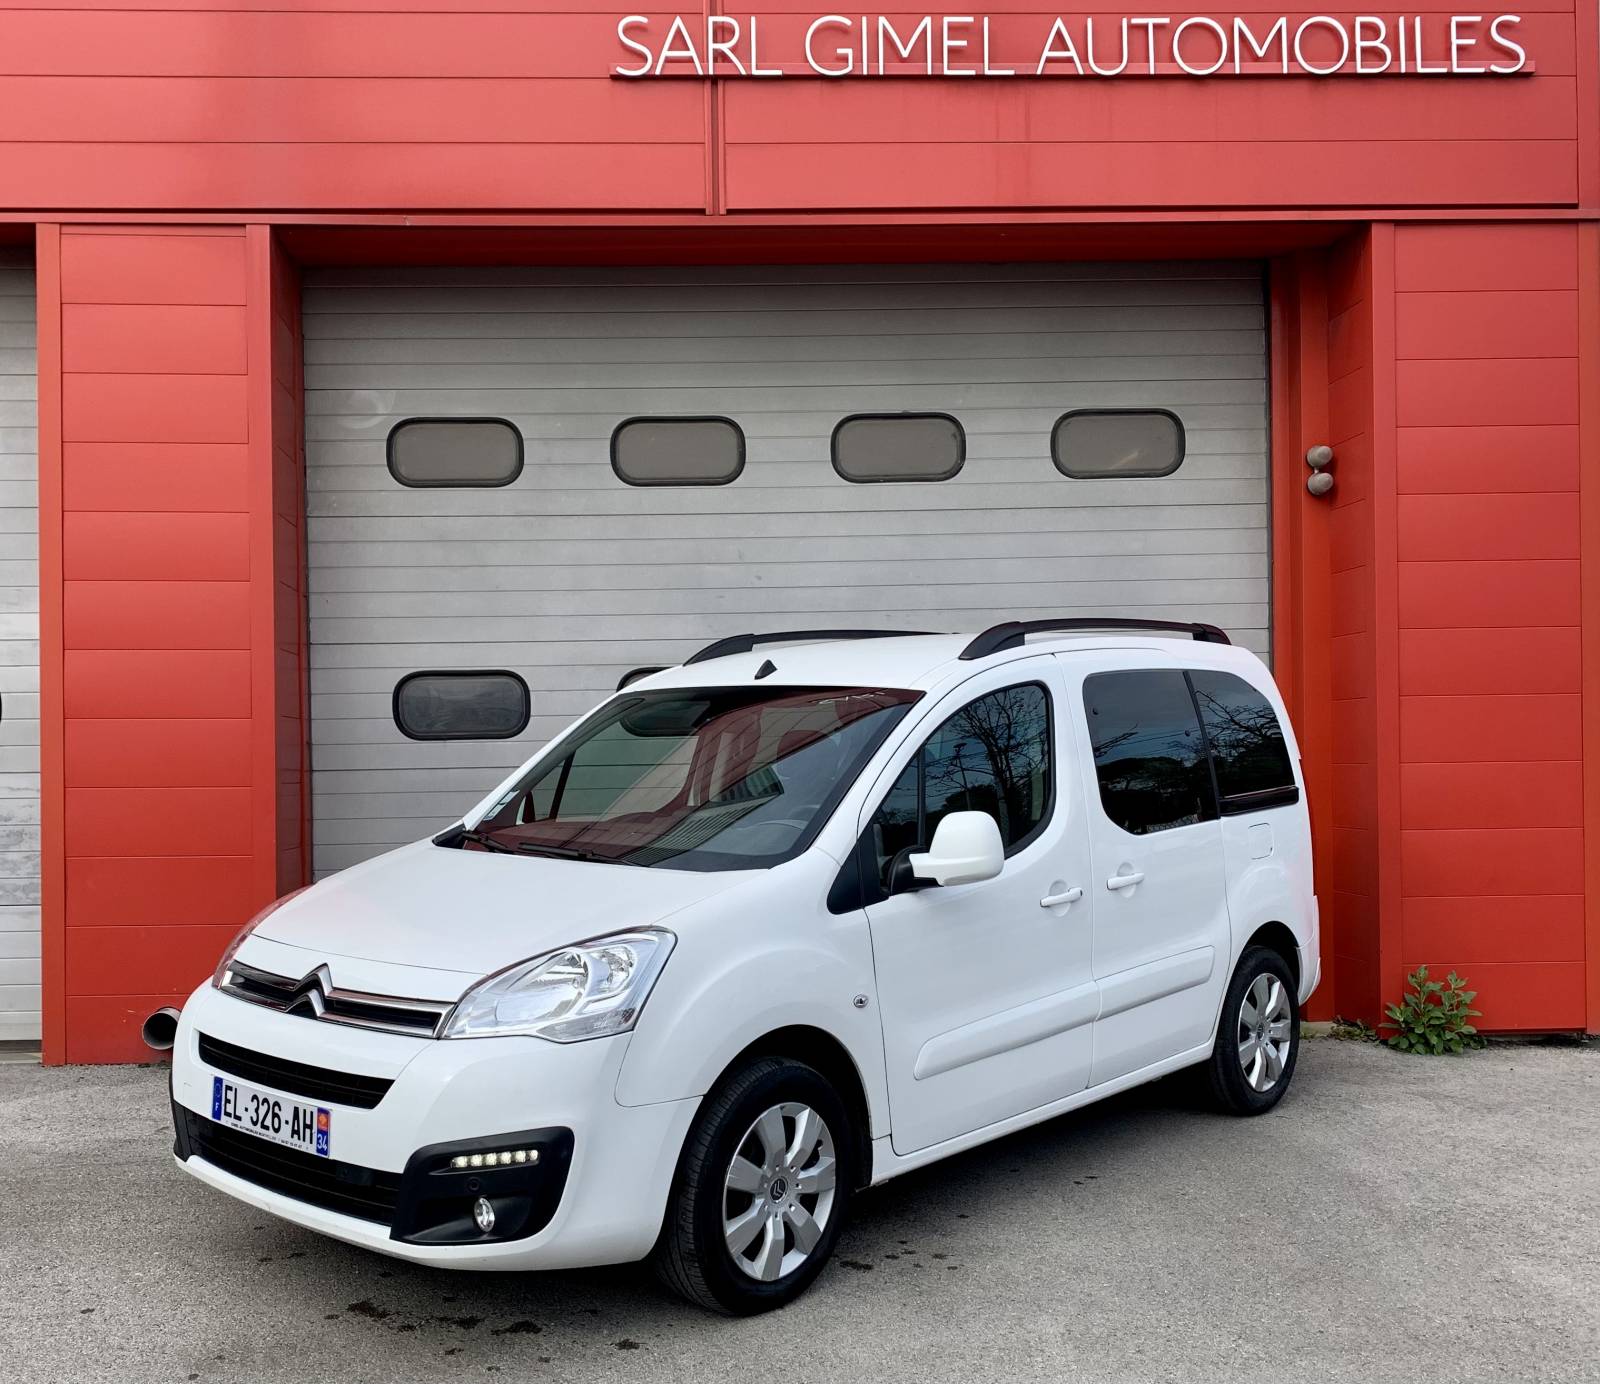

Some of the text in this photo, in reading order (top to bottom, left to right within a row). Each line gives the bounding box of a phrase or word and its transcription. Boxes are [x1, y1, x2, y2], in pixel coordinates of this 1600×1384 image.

[615, 14, 1526, 76] SARL GIMEL AUTOMOBILES
[223, 1084, 314, 1145] EL-326-AH
[317, 1133, 328, 1151] 34
